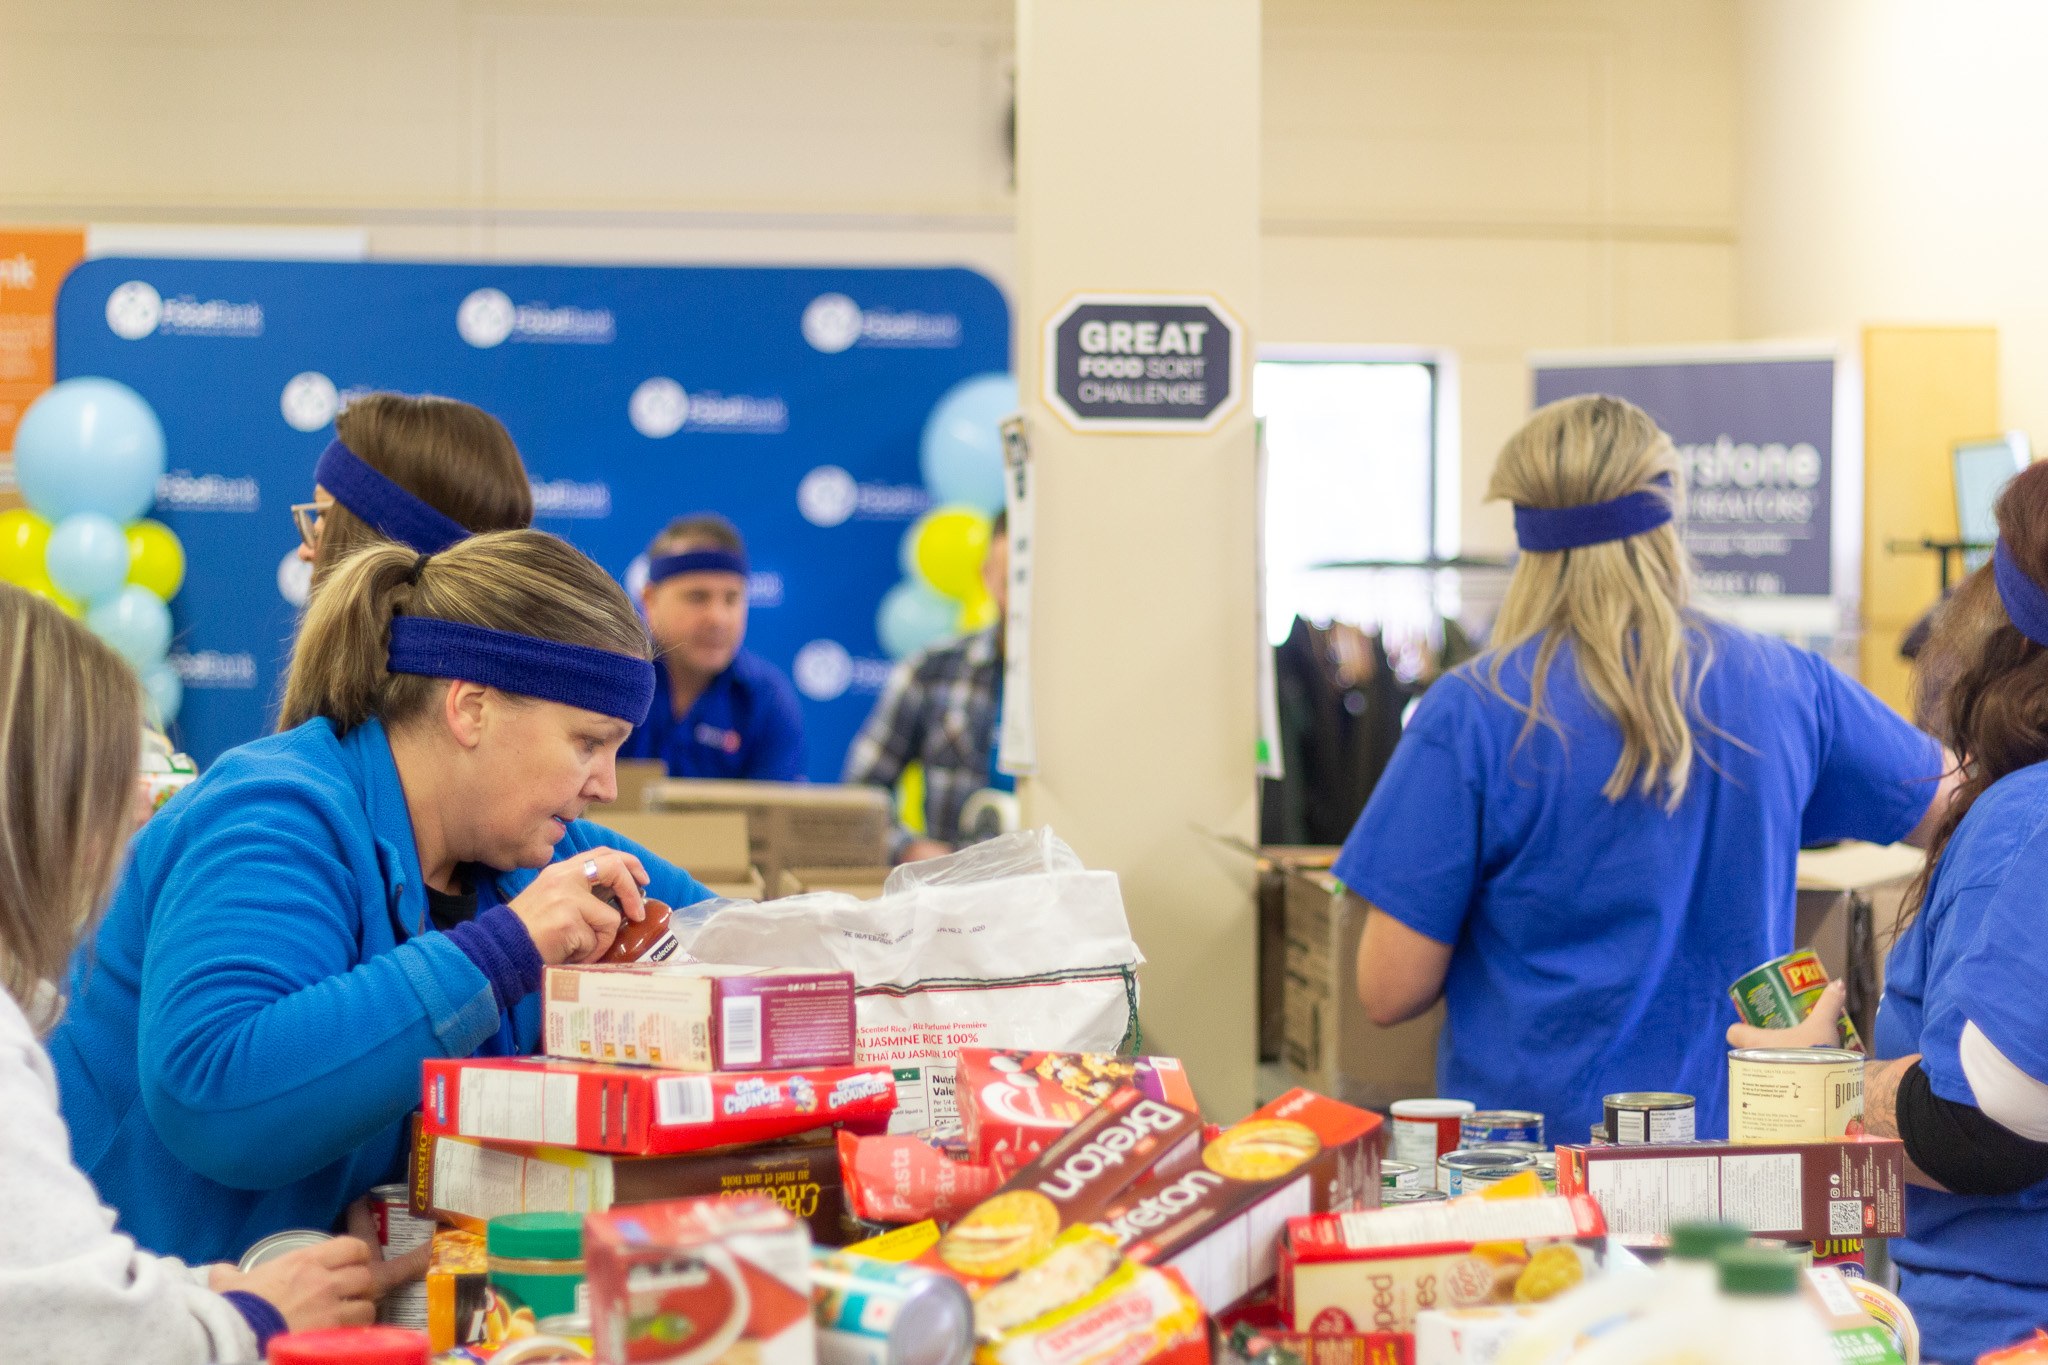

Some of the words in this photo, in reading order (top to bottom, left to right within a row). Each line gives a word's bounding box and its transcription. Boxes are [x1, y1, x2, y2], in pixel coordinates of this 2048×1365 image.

[1078, 320, 1210, 355] GREAT
[1078, 356, 1145, 379] FOOD
[1146, 356, 1207, 379] SORT
[1078, 380, 1208, 405] CHALLENGE
[860, 1025, 889, 1034] Scented
[890, 1024, 907, 1032] Rice
[924, 1022, 951, 1031] Parfumé
[953, 1021, 988, 1029] Première
[869, 1034, 920, 1048] JASMINE
[923, 1034, 943, 1045] RICE
[946, 1033, 979, 1044] 100%
[866, 1050, 889, 1062] THAÏ
[891, 1051, 906, 1060] AU
[908, 1049, 941, 1059] JASMIN
[724, 1086, 781, 1115] CRUNCH
[1038, 1099, 1184, 1199] Breton
[416, 1134, 429, 1212] Cheerio
[744, 1174, 763, 1185] aux
[764, 1172, 774, 1185] et
[775, 1171, 796, 1185] miel
[797, 1170, 810, 1181] au
[891, 1148, 912, 1210] Pasta
[721, 1175, 743, 1188] noix
